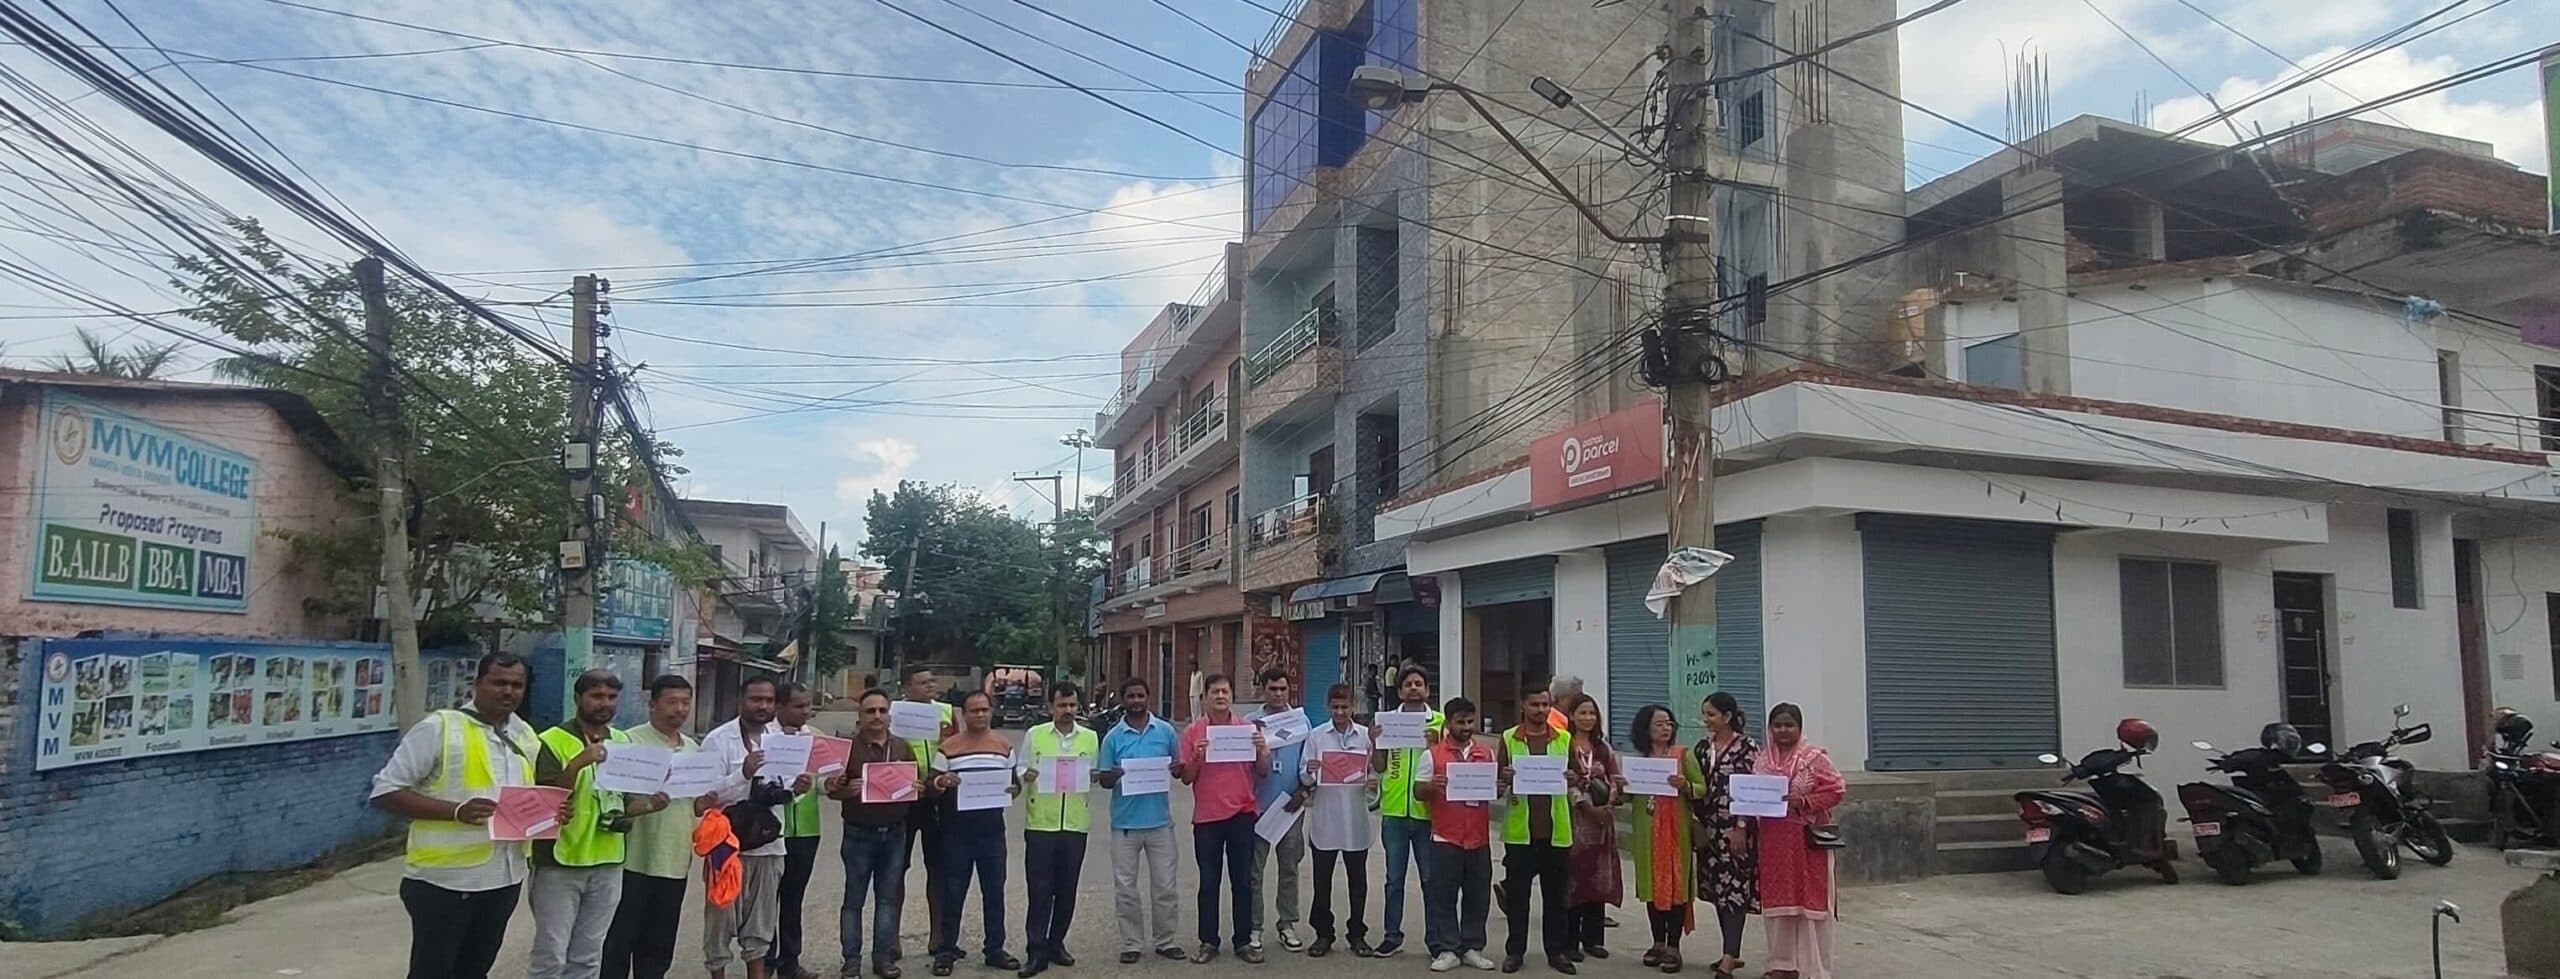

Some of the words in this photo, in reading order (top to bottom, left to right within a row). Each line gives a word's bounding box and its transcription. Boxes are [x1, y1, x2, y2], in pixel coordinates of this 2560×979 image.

[92, 417, 173, 470] MVM
[175, 445, 249, 500] COLLEGE
[1582, 437, 1619, 464] parcel
[99, 503, 165, 534] Proposed
[167, 517, 223, 545] Programs
[145, 547, 189, 591] BBA
[202, 555, 243, 597] MBA
